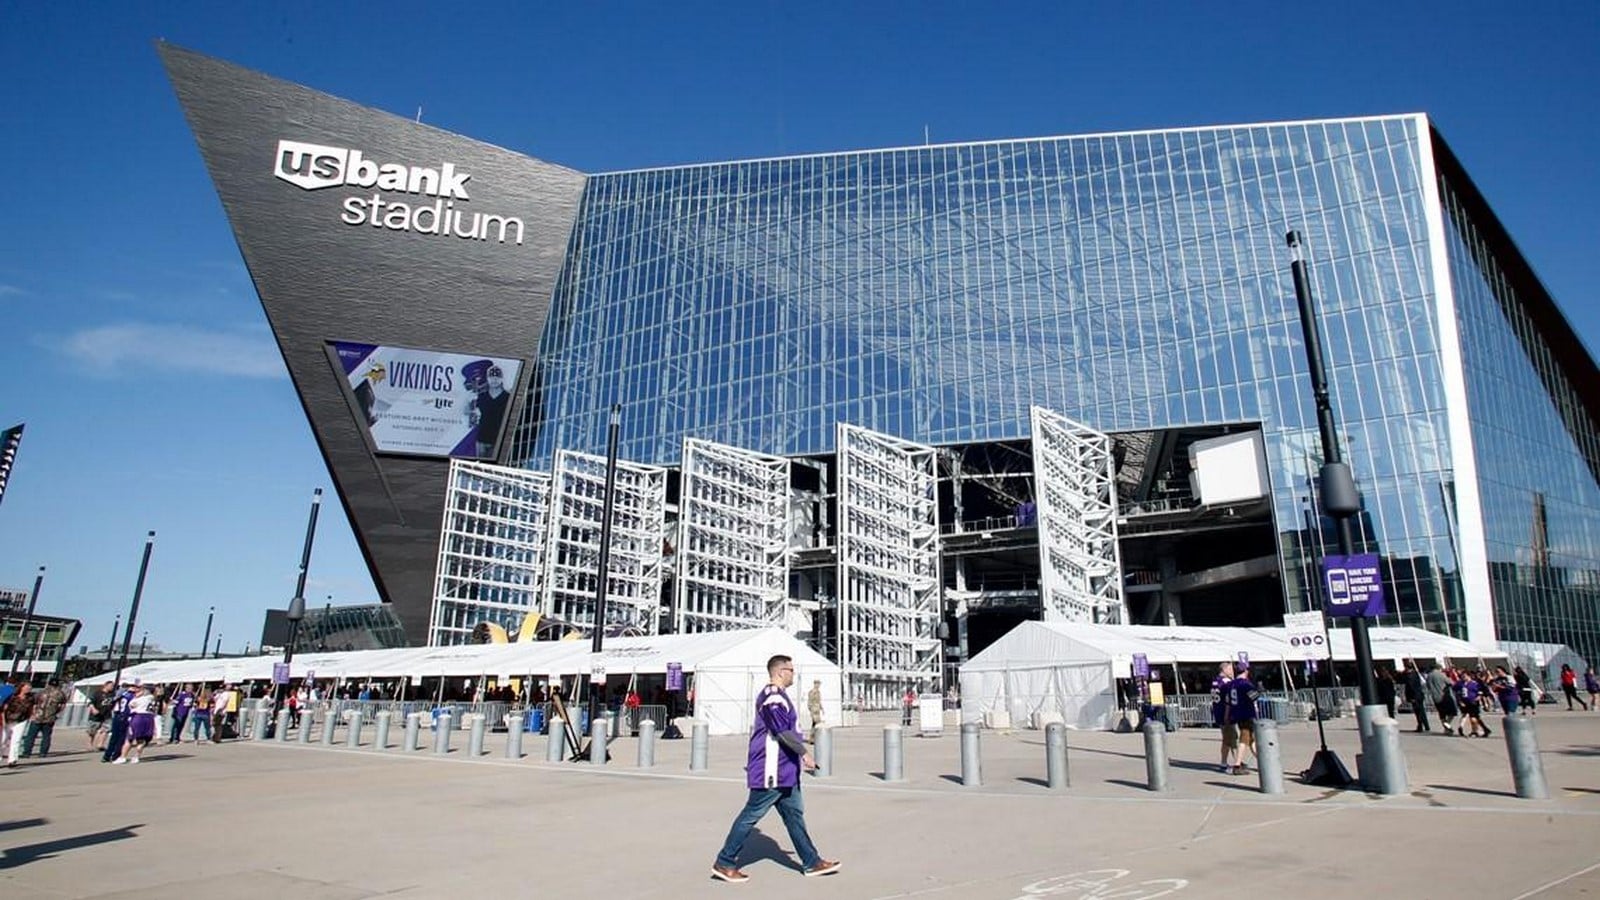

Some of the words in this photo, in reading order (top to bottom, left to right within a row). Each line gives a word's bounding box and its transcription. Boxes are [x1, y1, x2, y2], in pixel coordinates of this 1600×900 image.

[340, 193, 525, 245] stadium
[389, 360, 455, 393] VIKINGS
[434, 397, 454, 410] Lite
